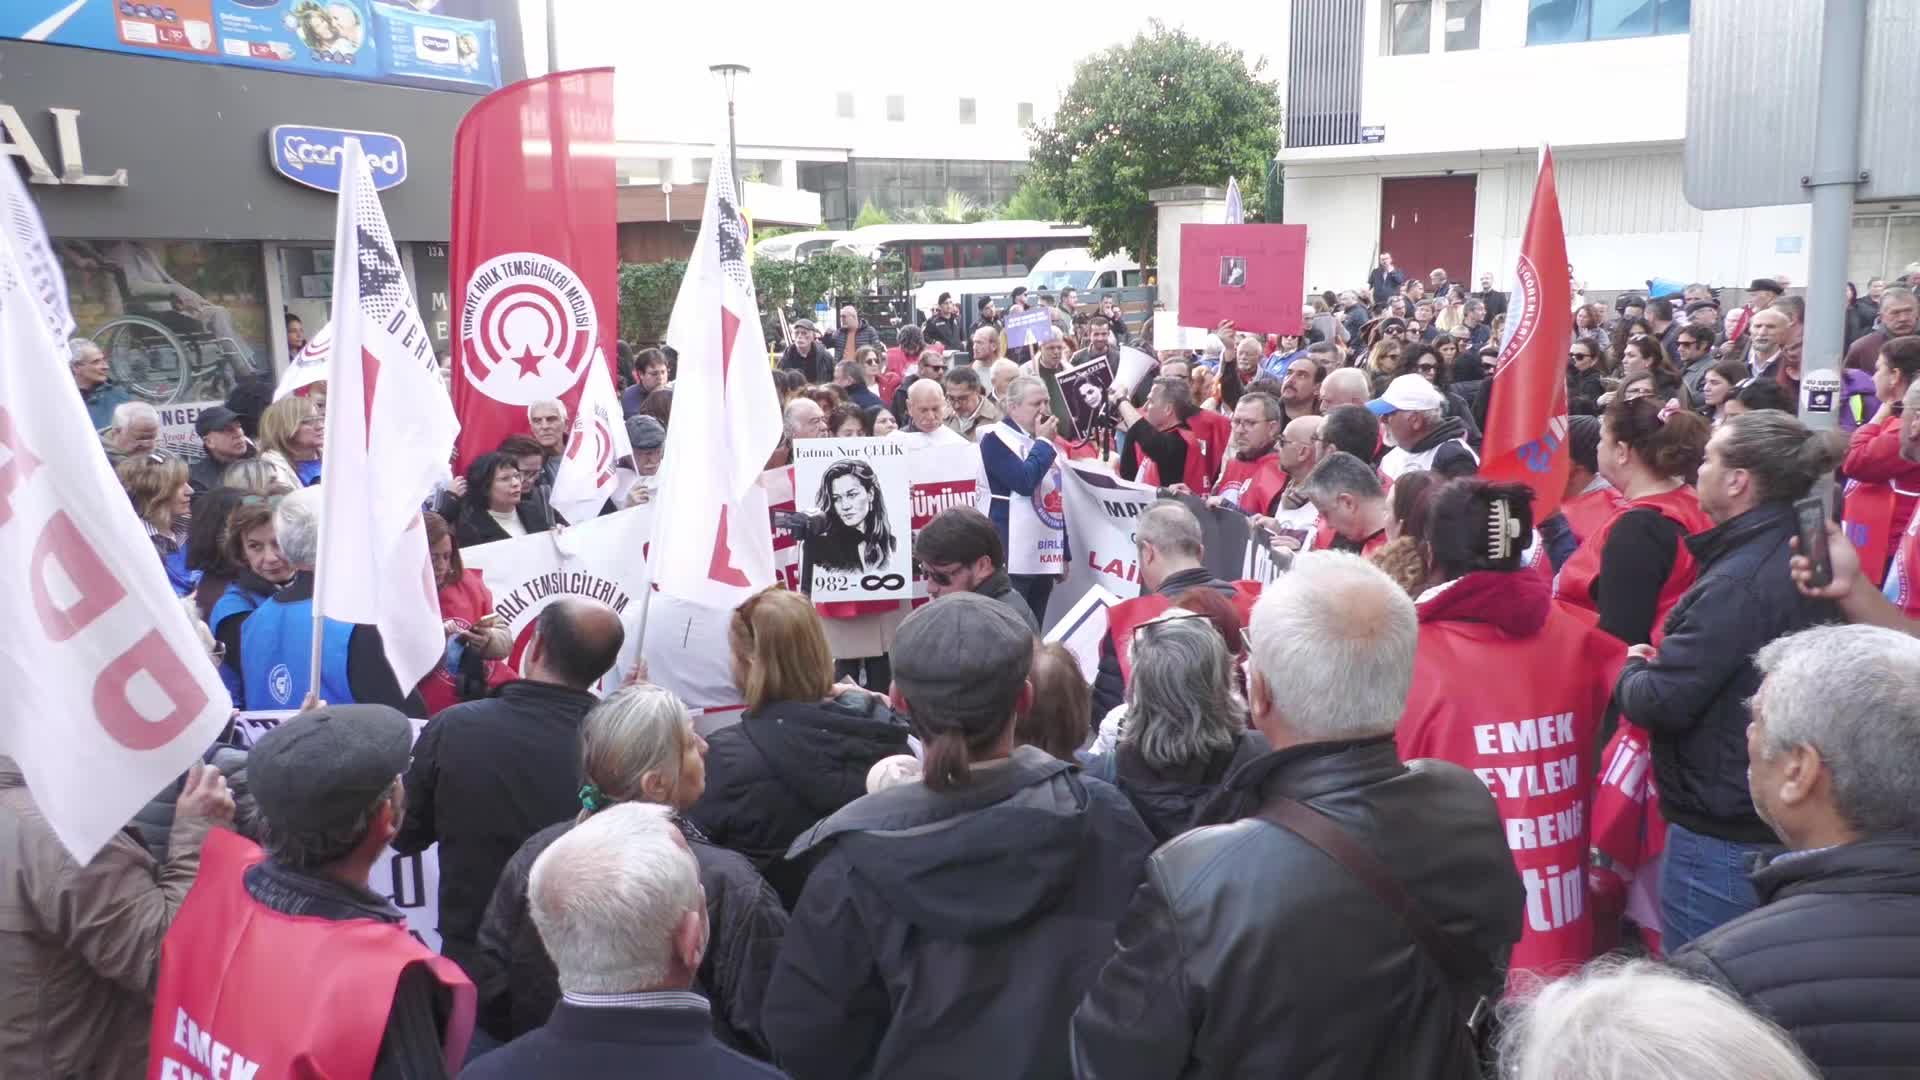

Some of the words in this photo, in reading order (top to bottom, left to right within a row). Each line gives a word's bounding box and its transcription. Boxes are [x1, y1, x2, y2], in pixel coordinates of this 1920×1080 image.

[473, 266, 503, 295] HALK
[500, 257, 574, 291] TEMSİLCİLERİ
[161, 408, 198, 426] NGE
[796, 445, 833, 458] Fatma
[837, 446, 861, 457] Nur
[864, 441, 904, 460] ÇELİK
[1039, 553, 1064, 563] KAM
[495, 589, 530, 627] ALK
[522, 567, 619, 604] TEMSİLCİLERİ
[1473, 712, 1575, 755] EMEK
[1472, 754, 1578, 799] EYLEM
[173, 1005, 260, 1080] EMEK
